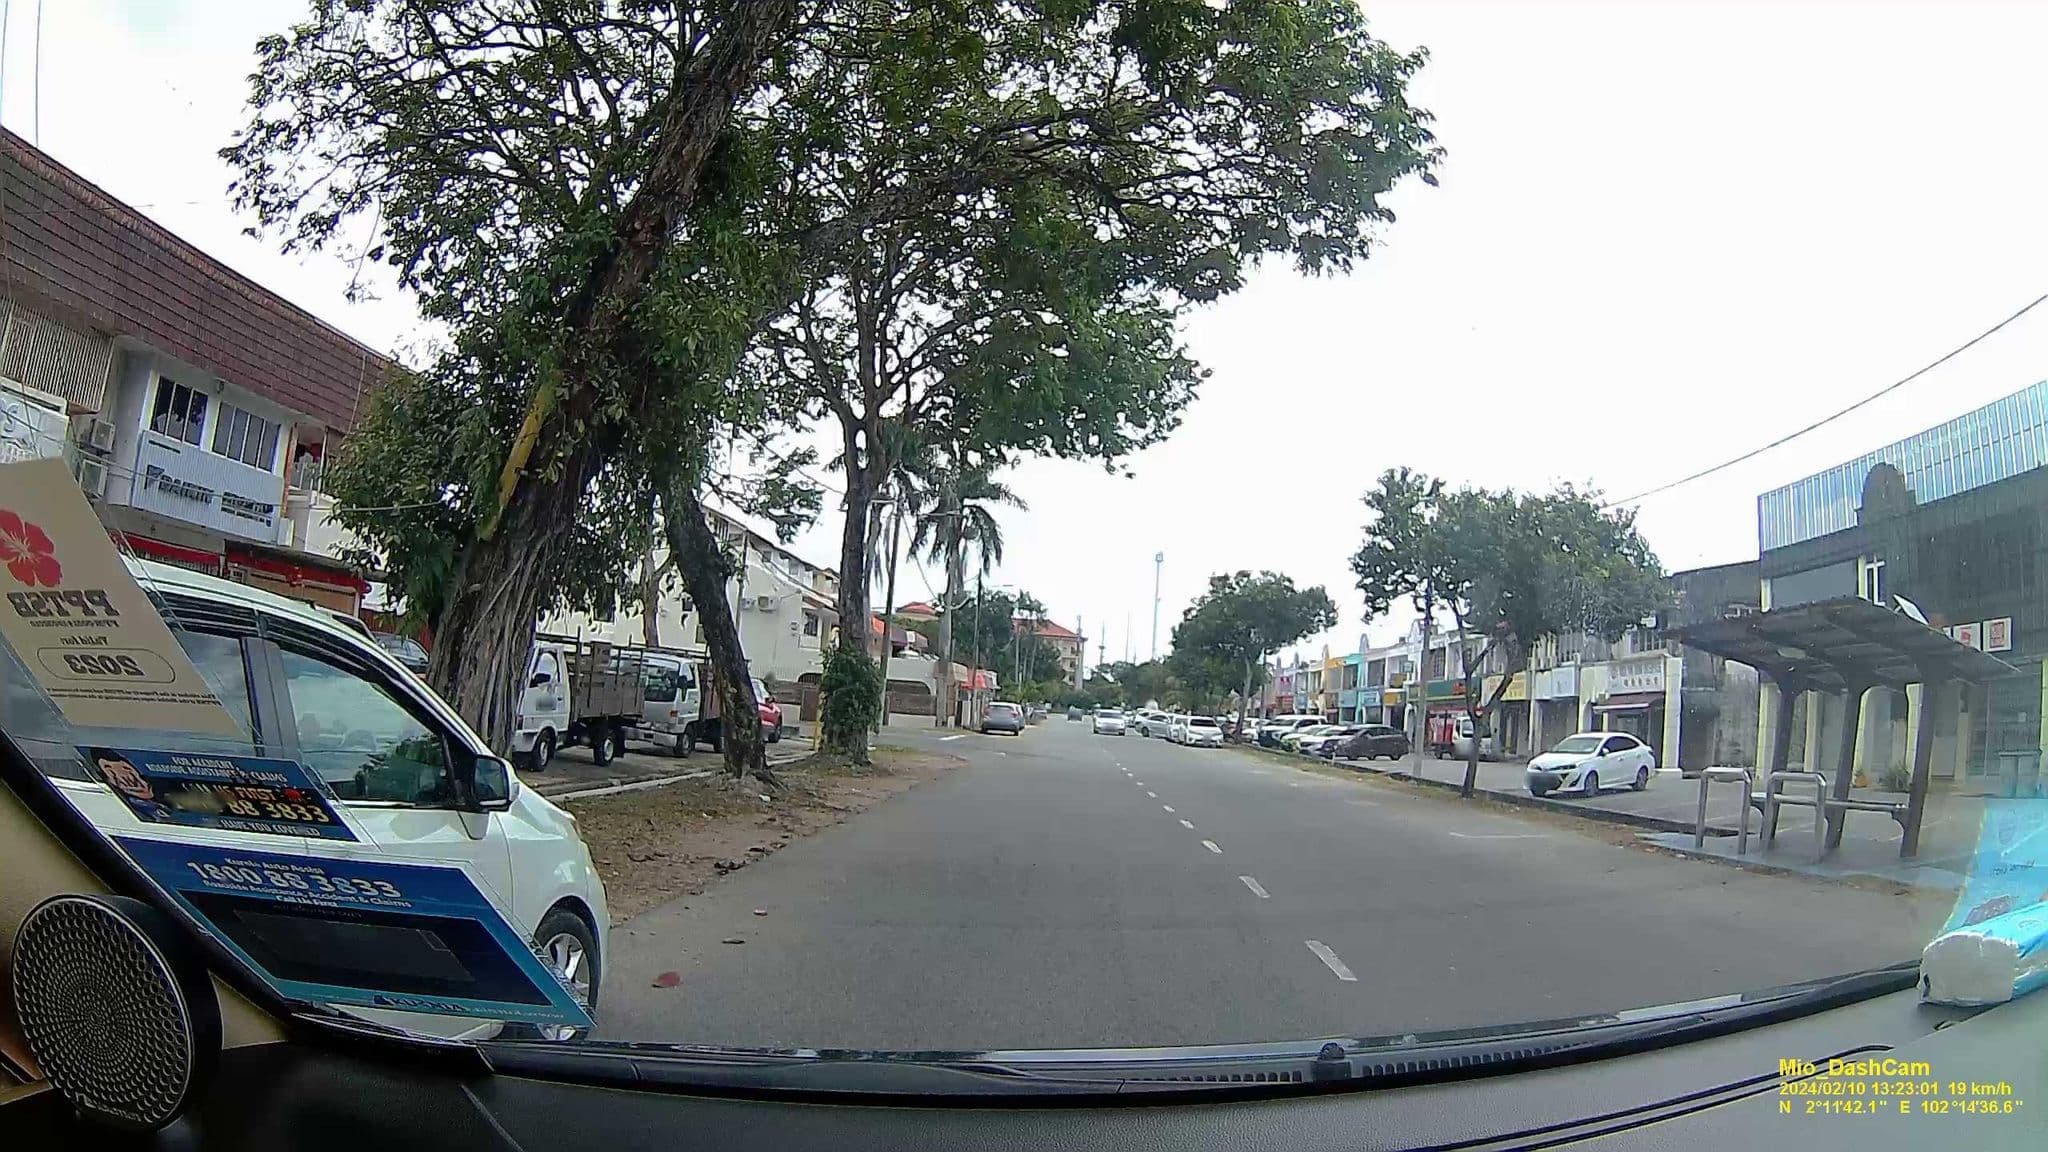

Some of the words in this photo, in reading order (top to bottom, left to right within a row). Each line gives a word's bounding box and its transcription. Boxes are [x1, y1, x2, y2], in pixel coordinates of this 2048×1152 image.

[171, 756, 192, 767] FOR
[234, 786, 277, 802] FIRST
[226, 800, 260, 817] 88
[264, 802, 330, 824] 3833
[250, 822, 272, 833] YOU
[187, 862, 263, 885] 1800
[264, 870, 310, 890] 88
[309, 875, 401, 898] 3833
[369, 897, 412, 909] Claims
